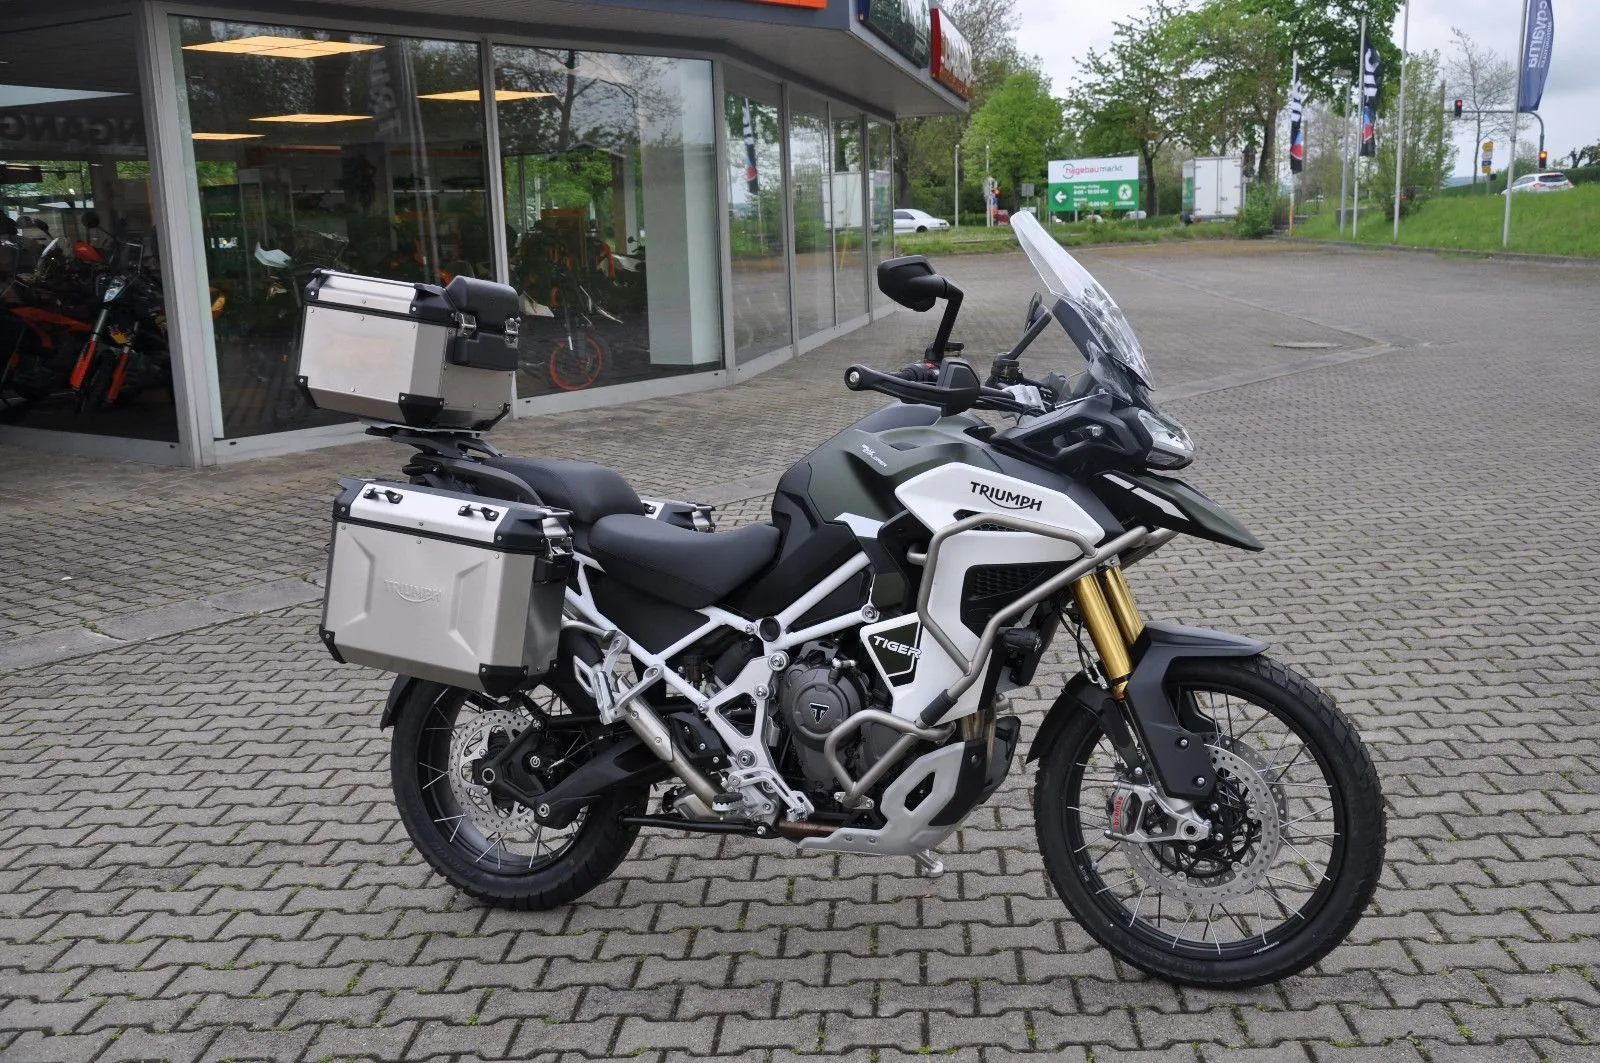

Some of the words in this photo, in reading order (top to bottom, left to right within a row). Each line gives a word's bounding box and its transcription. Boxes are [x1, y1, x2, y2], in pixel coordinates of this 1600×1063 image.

[1065, 165, 1124, 175] hagebaumarkt
[970, 481, 1043, 512] TRIUMPH
[384, 579, 442, 603] TRIUMPH
[873, 635, 922, 660] TIGER
